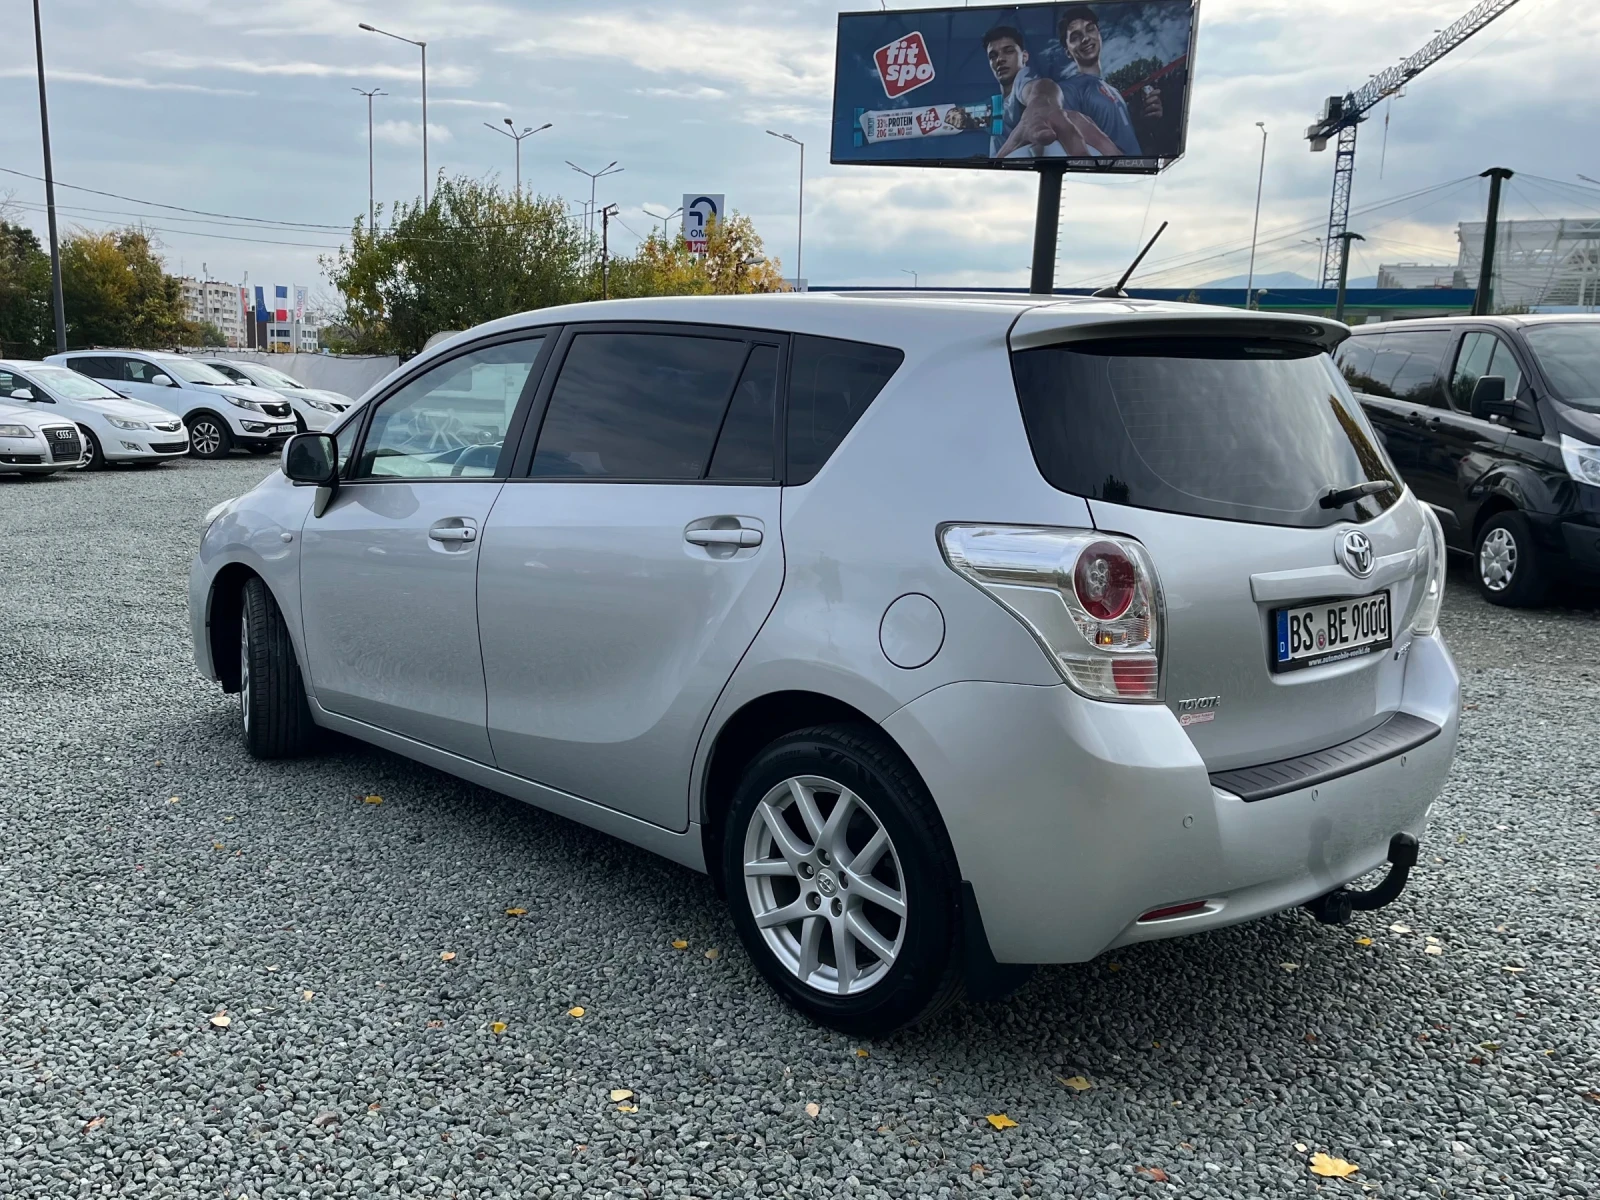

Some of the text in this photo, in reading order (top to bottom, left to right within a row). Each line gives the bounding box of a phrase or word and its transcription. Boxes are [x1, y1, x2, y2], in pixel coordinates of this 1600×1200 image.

[886, 41, 919, 65] fit
[886, 63, 932, 87] spo
[888, 116, 913, 127] PROTEIN
[920, 111, 936, 122] fit
[920, 119, 941, 131] spo
[897, 127, 906, 136] NO
[690, 229, 707, 238] OM
[1290, 598, 1387, 654] BS BE 9000
[1280, 642, 1286, 653] D
[1178, 695, 1221, 710] TOYOTA
